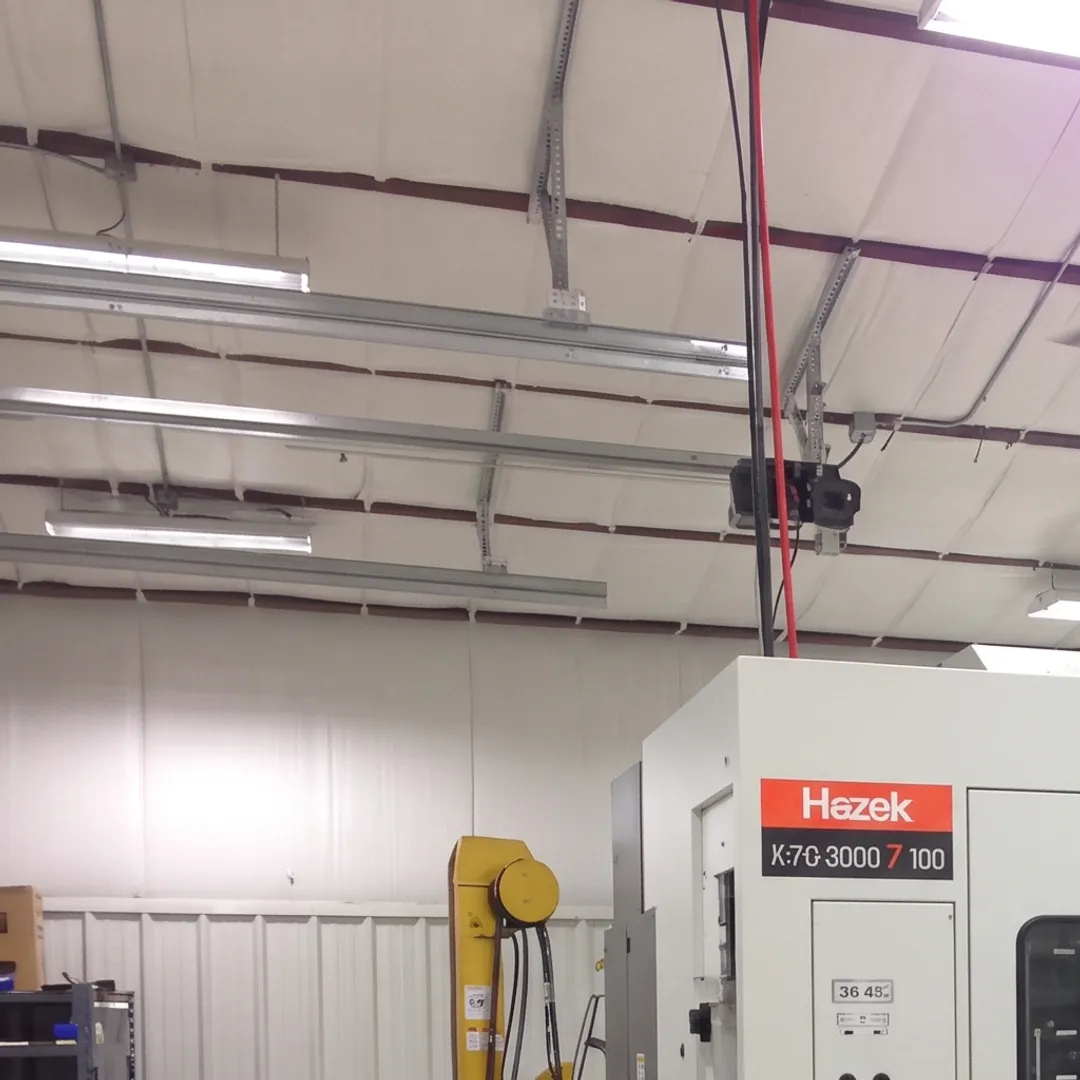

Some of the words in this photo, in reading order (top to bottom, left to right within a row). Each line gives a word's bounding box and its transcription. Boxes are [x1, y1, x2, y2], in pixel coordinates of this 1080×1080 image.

[802, 786, 915, 823] Hazek
[886, 843, 904, 869] 7
[909, 848, 945, 870] 100
[839, 985, 859, 998] 36
